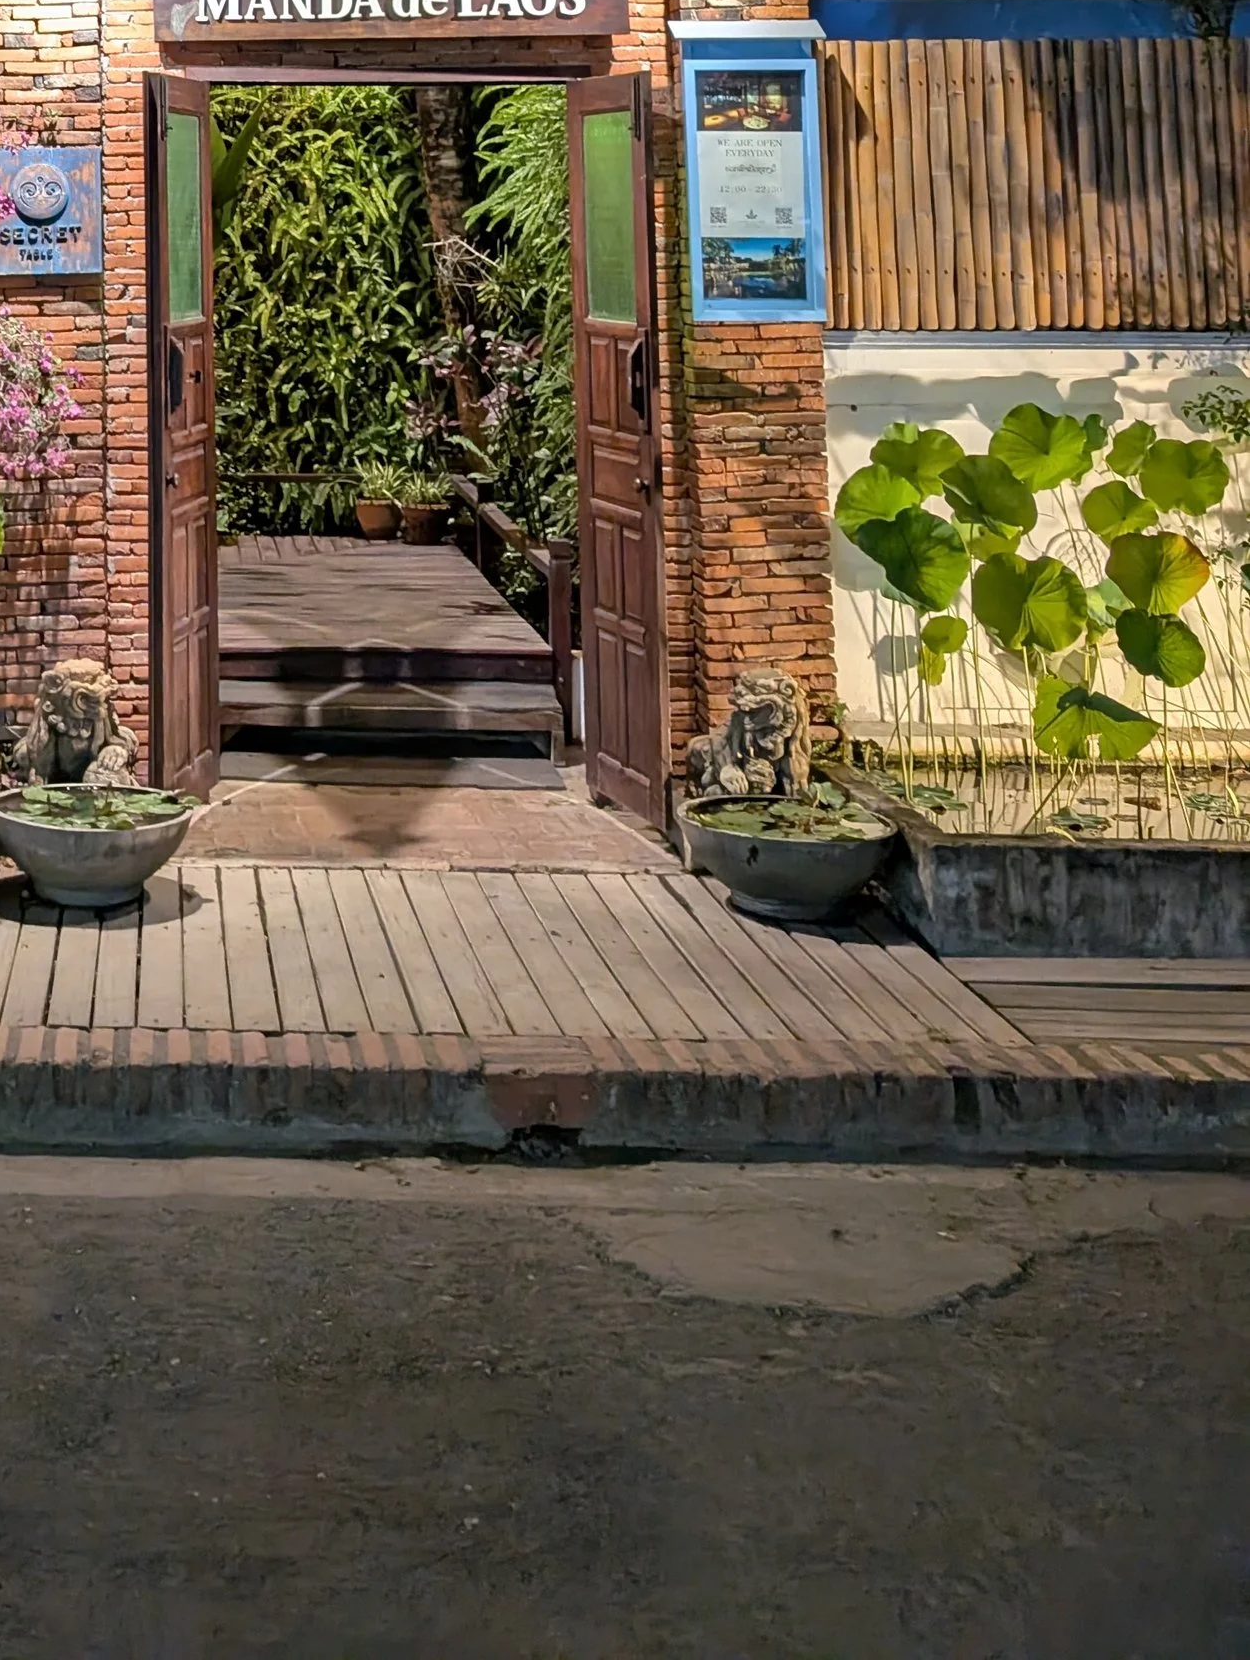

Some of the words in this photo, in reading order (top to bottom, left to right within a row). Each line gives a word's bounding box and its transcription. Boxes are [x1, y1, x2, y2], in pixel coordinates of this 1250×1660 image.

[734, 139, 754, 147] ARE
[756, 139, 783, 147] OPEN
[725, 149, 775, 157] EVERYDAY
[0, 226, 82, 246] SECRET
[19, 249, 53, 262] TABLE
